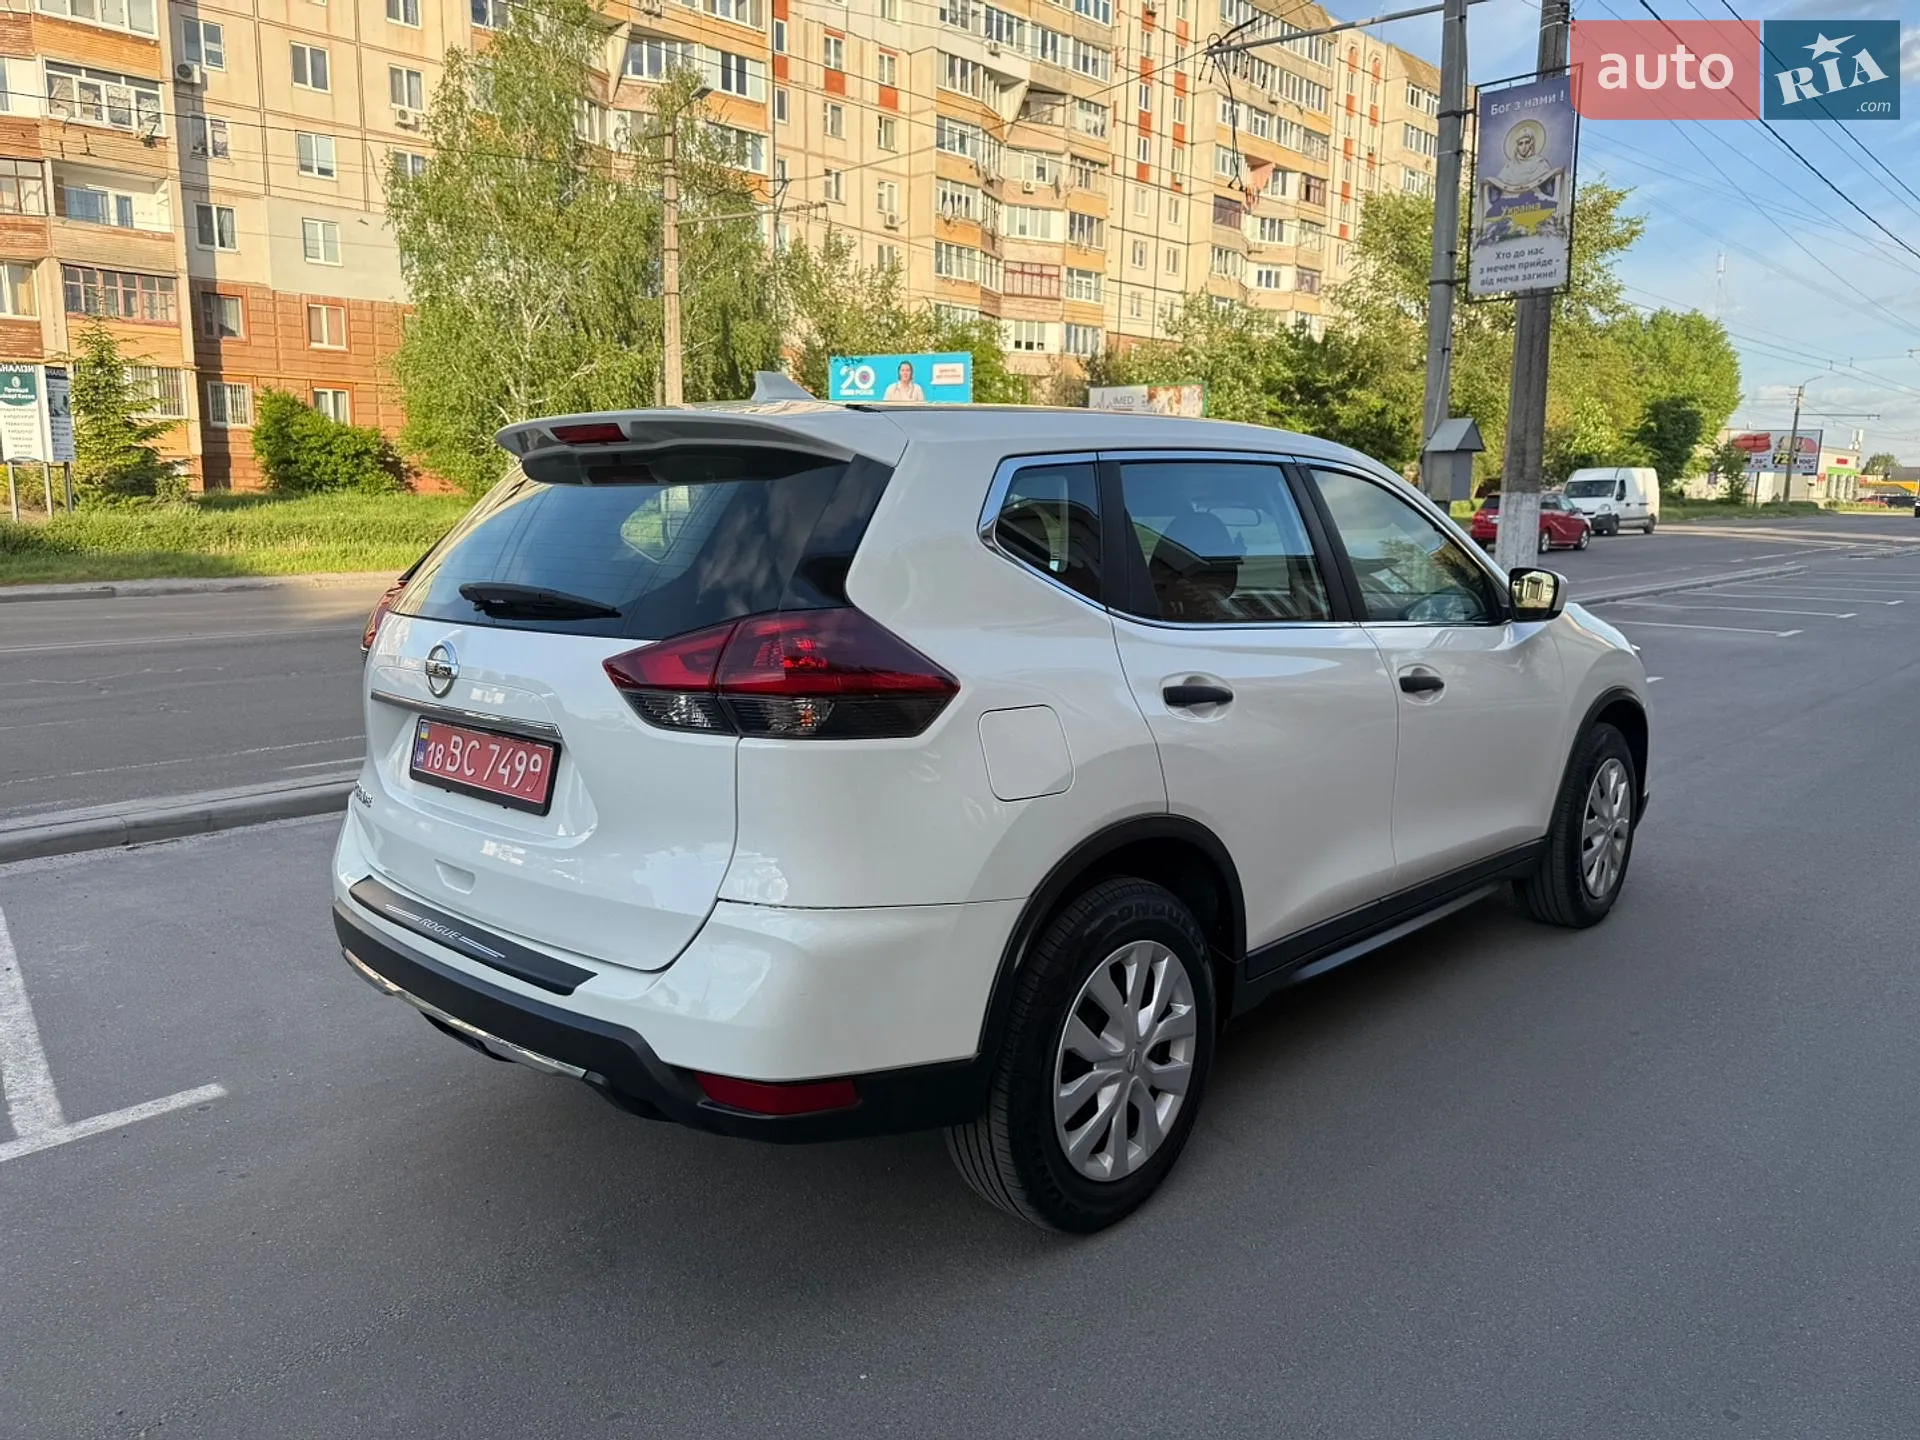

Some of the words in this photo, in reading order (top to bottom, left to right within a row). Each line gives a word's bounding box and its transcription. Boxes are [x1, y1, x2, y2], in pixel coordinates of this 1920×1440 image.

[1491, 103, 1511, 116] Бог
[1524, 94, 1556, 108] нами
[1495, 251, 1511, 260] Хто
[1513, 250, 1525, 259] до
[1527, 247, 1544, 256] нас
[1480, 278, 1494, 286] від
[1496, 275, 1519, 284] меча
[1521, 268, 1557, 281] загине!
[1486, 263, 1516, 274] мечем
[1518, 258, 1553, 271] прийде
[840, 365, 875, 390] 20
[427, 741, 443, 770] 18
[446, 735, 480, 776] BC
[483, 743, 542, 792] 7499
[420, 918, 461, 941] ROGUE
